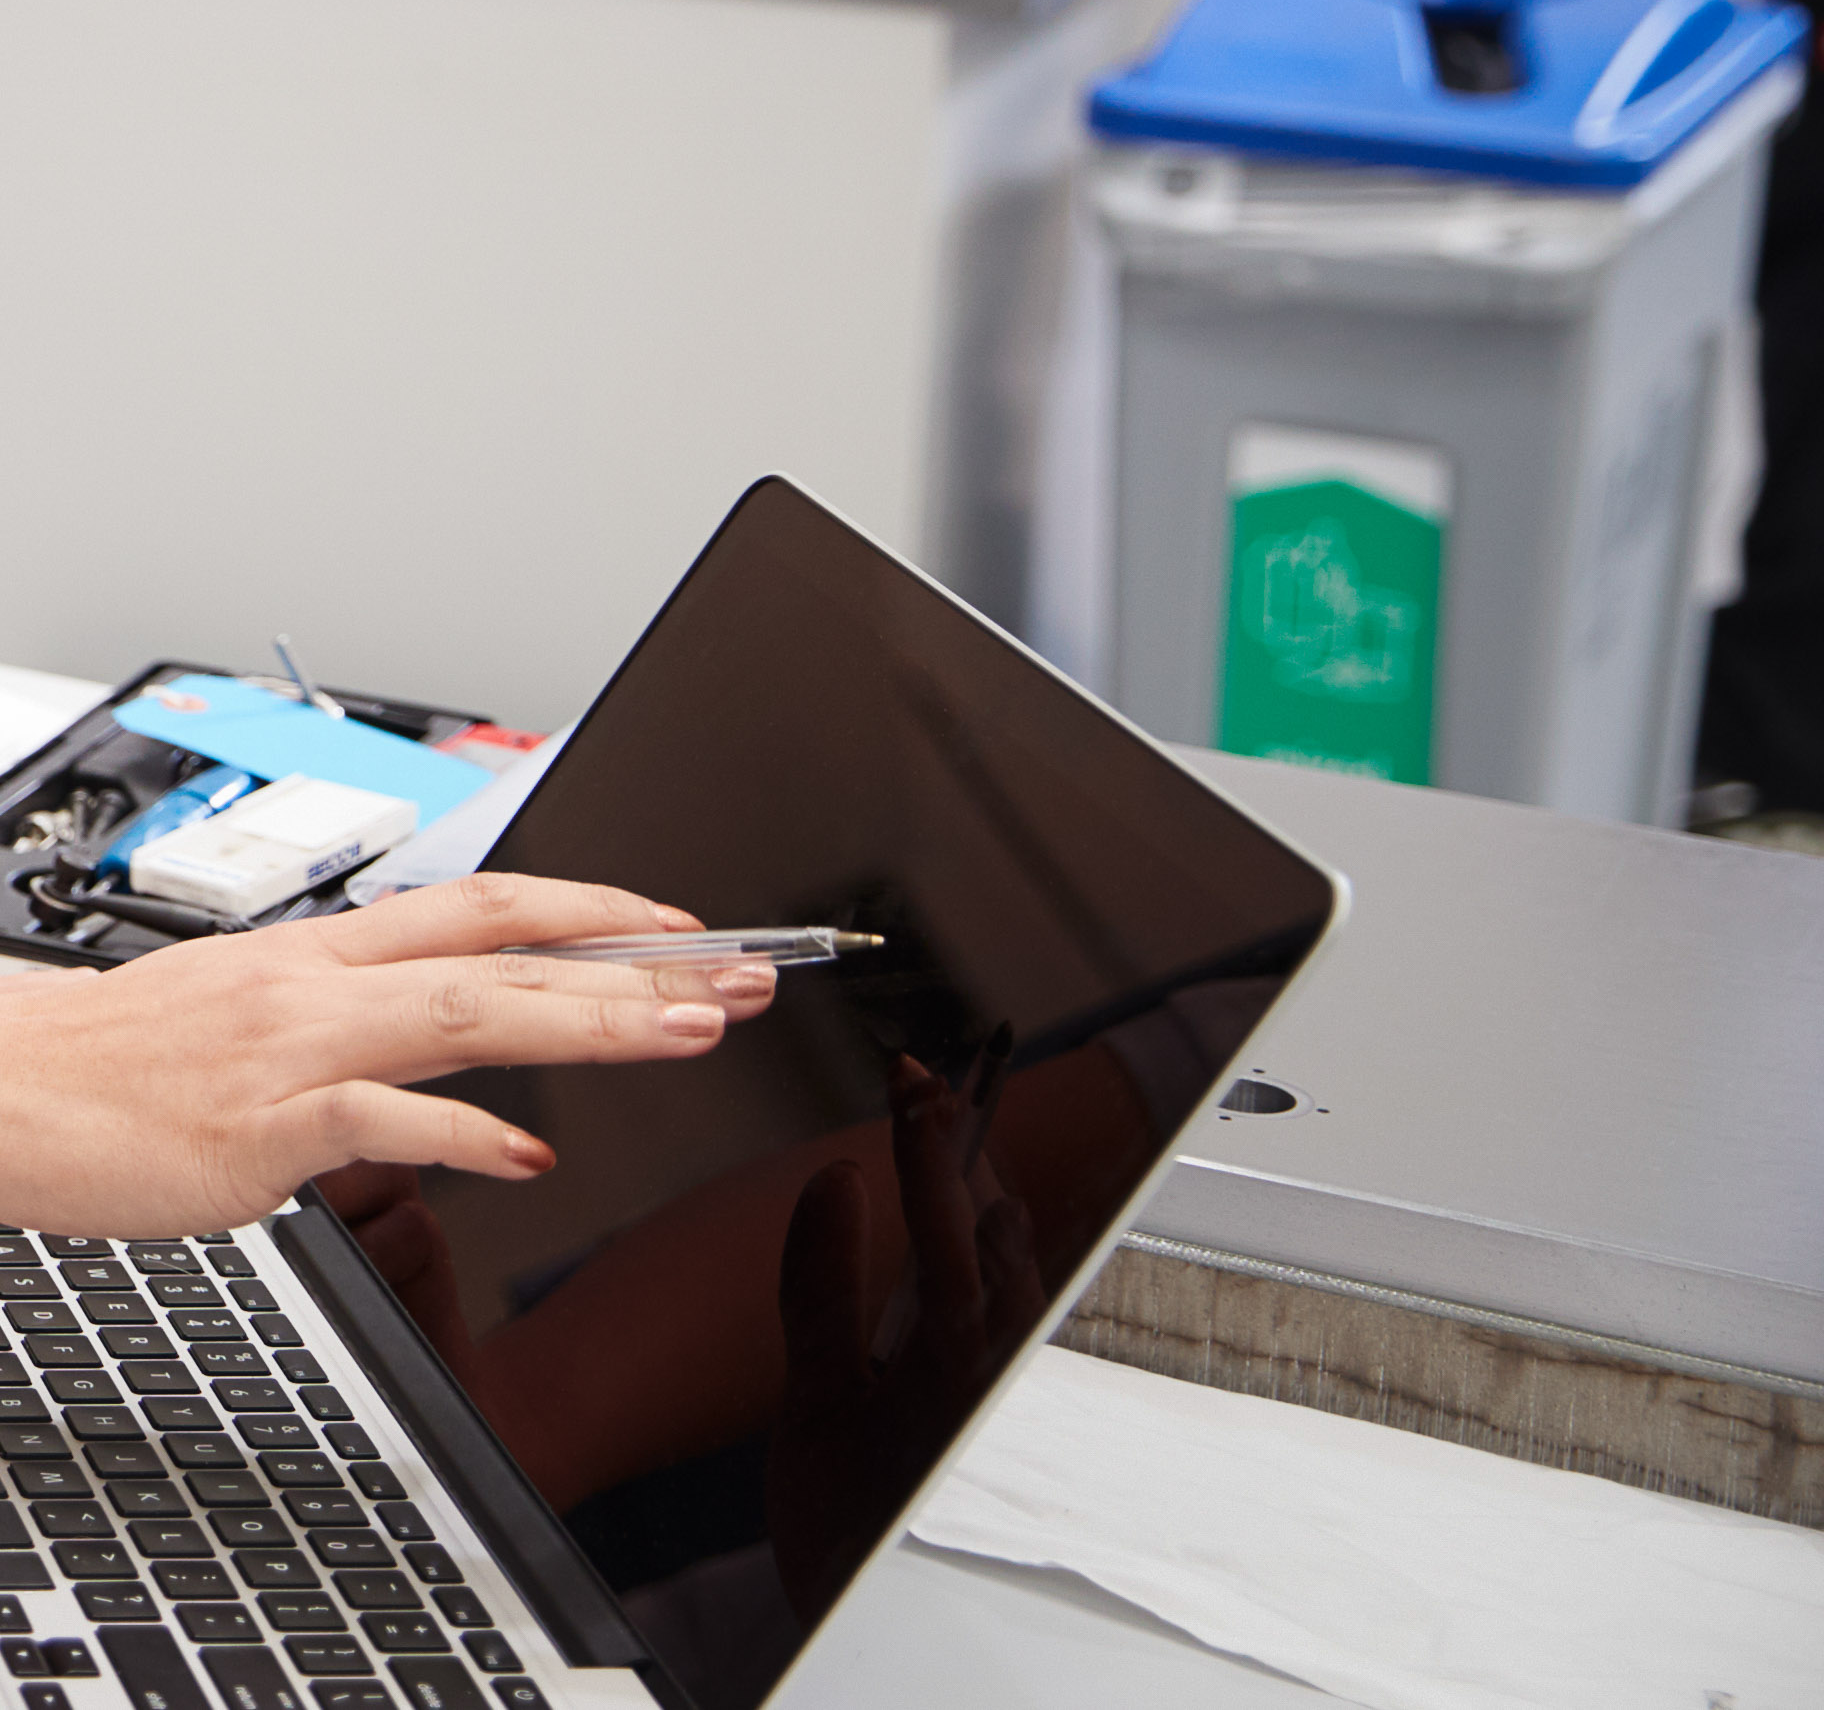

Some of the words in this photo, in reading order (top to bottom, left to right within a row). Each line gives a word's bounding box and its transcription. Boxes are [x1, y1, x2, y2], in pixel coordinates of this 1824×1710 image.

[68, 1238, 88, 1246] Q
[143, 1253, 162, 1261] 2
[87, 1268, 109, 1279] W
[33, 1311, 53, 1320] D
[212, 1319, 231, 1327] $
[74, 1380, 94, 1389] G
[94, 1417, 115, 1425] H
[20, 1436, 42, 1444] N
[194, 1444, 216, 1453] U
[40, 1472, 64, 1483] M
[137, 1493, 160, 1501] K
[241, 1521, 263, 1531] O
[161, 1533, 181, 1541] L
[266, 1563, 289, 1572] P
